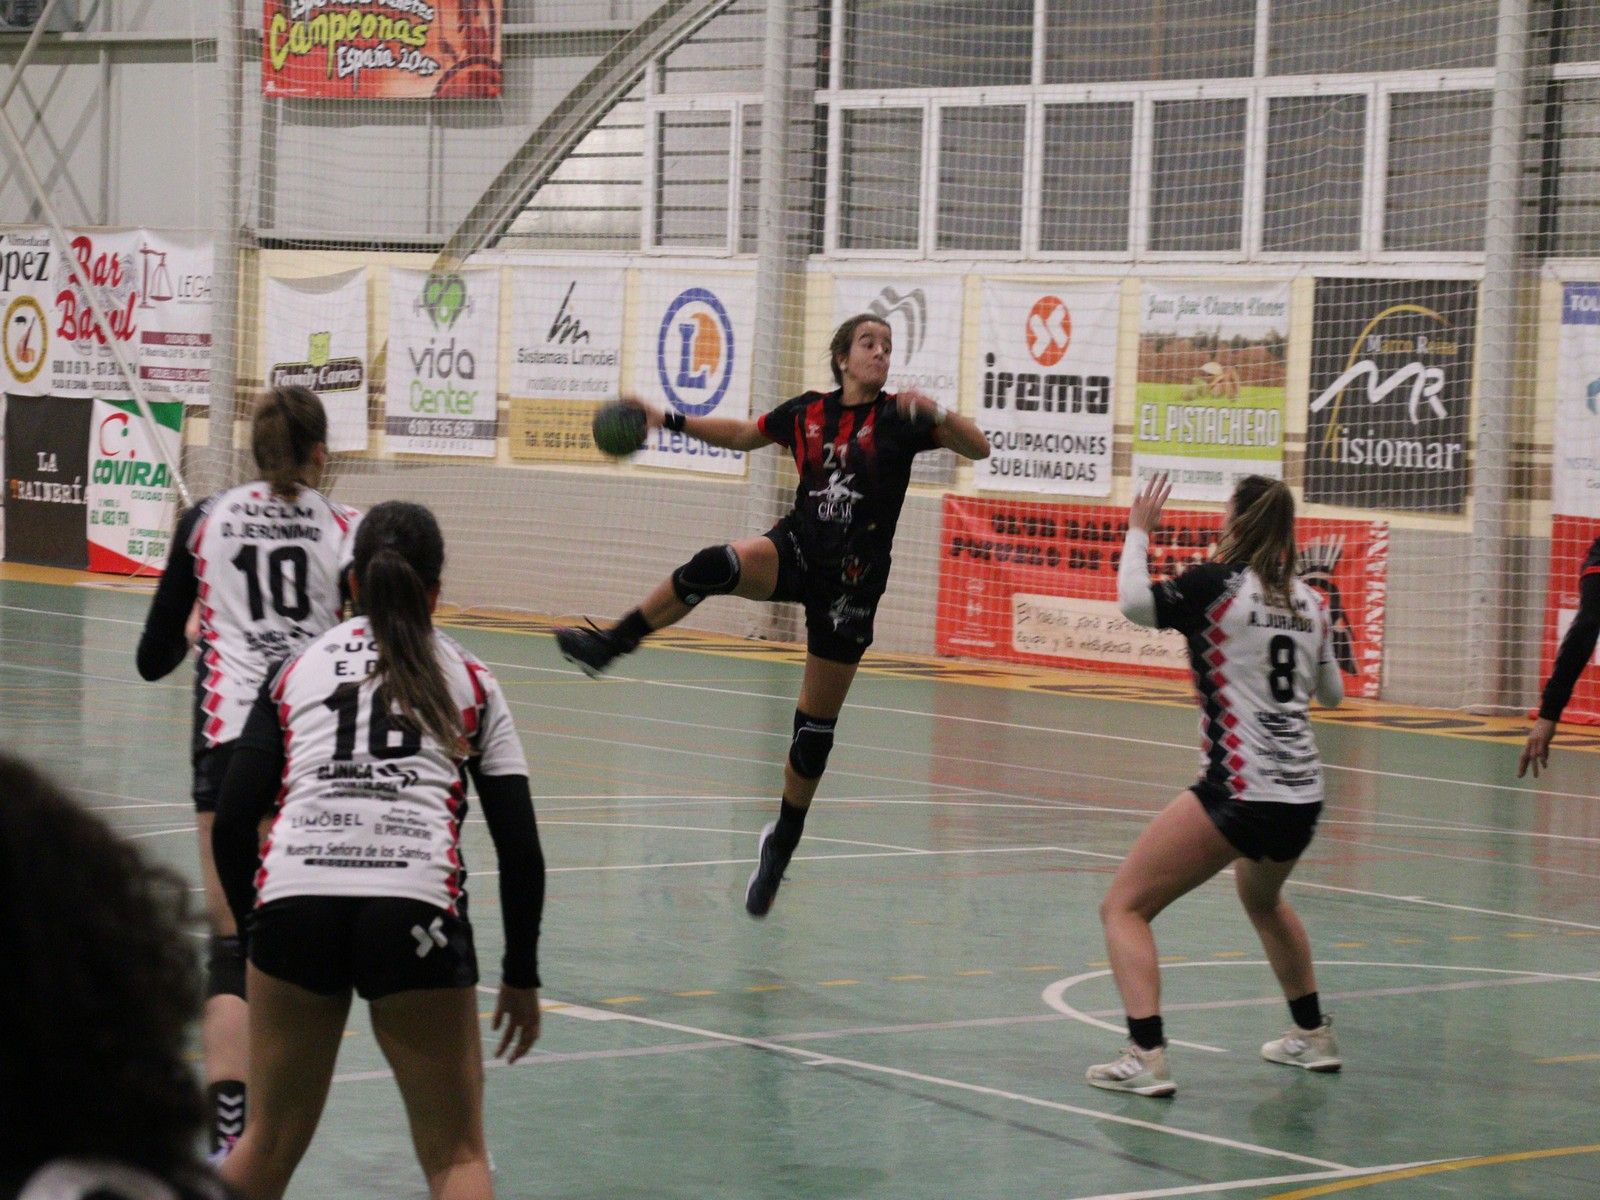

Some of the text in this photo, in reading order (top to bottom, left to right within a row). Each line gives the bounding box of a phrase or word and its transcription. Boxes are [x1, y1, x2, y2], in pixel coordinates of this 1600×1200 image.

[270, 9, 428, 79] Campeonas
[338, 44, 396, 92] España
[0, 250, 50, 291] pez
[69, 236, 124, 287] Bar
[408, 337, 475, 380] vida
[517, 347, 568, 365] Sistemas
[274, 367, 318, 390] Family
[409, 379, 480, 415] Center
[984, 351, 1110, 415] irema
[1139, 402, 1281, 448] EL PISTACHERO
[37, 452, 59, 472] LA
[823, 442, 848, 469] 21
[990, 456, 1097, 482] SUBLIMADAS
[245, 502, 315, 521] UCLM
[231, 544, 312, 622] 10
[1268, 634, 1296, 703] 8
[325, 842, 362, 857] Señora
[365, 844, 378, 857] de
[397, 845, 431, 861] Santos
